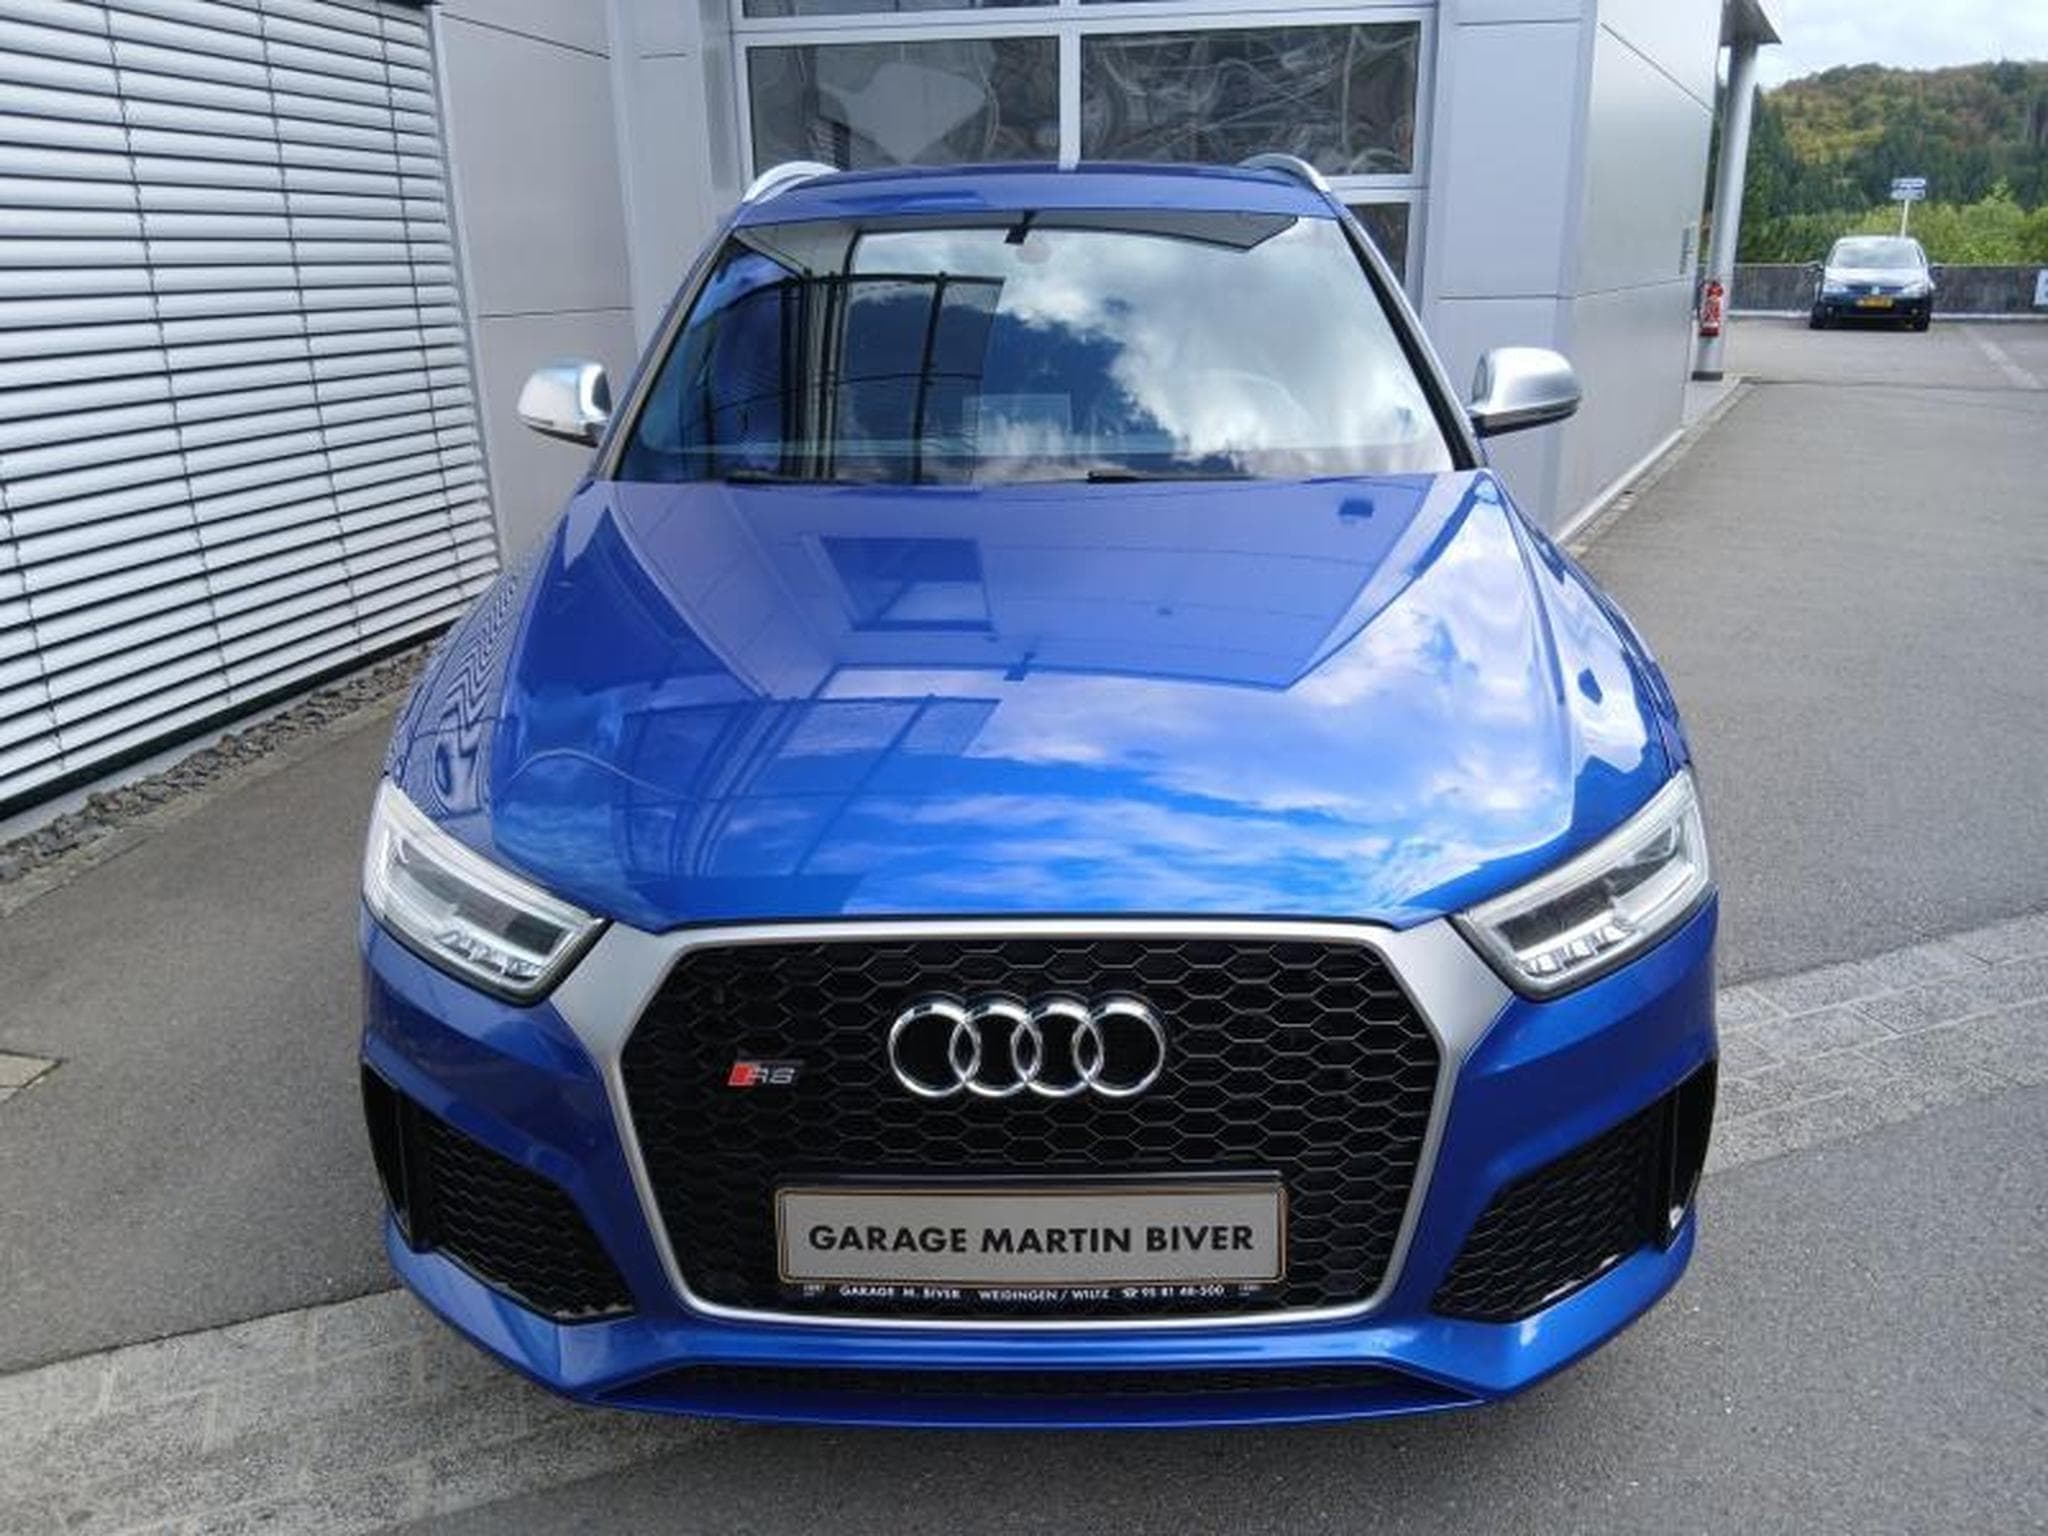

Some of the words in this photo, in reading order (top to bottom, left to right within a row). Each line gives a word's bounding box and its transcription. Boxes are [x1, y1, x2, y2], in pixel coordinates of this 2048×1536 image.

[808, 1225, 967, 1253] GARAGE
[980, 1227, 1131, 1254] MARTIN
[1146, 1225, 1254, 1252] BIVER
[839, 1285, 894, 1297] GARAGE
[923, 1287, 961, 1299] BIVER
